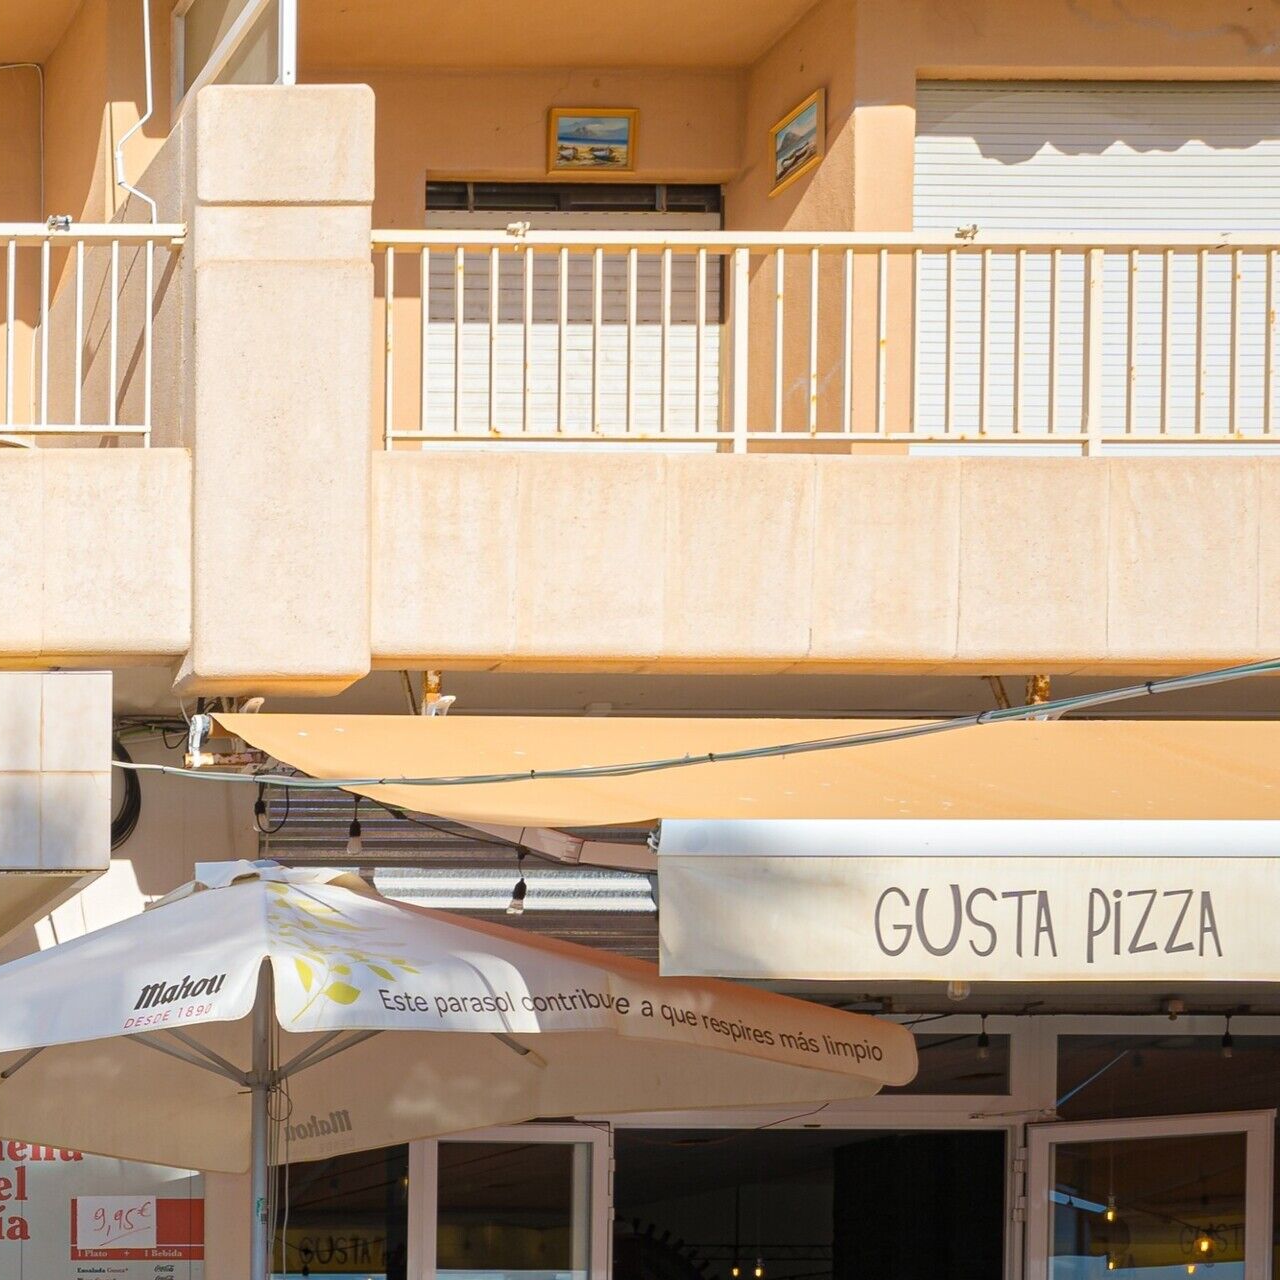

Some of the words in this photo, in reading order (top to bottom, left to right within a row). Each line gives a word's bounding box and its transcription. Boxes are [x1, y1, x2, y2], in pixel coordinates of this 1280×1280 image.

[874, 884, 1058, 958] GUSTA
[123, 1010, 172, 1029] DESDE
[177, 1003, 213, 1018] 1890
[133, 974, 227, 1011] Mahou
[378, 989, 429, 1013] Este
[434, 991, 516, 1018] parasol
[521, 988, 631, 1015] contribue
[640, 1000, 654, 1017] a
[660, 1003, 697, 1027] que
[702, 1013, 775, 1046] respires
[779, 1030, 820, 1054] más
[823, 1034, 883, 1064] limpio
